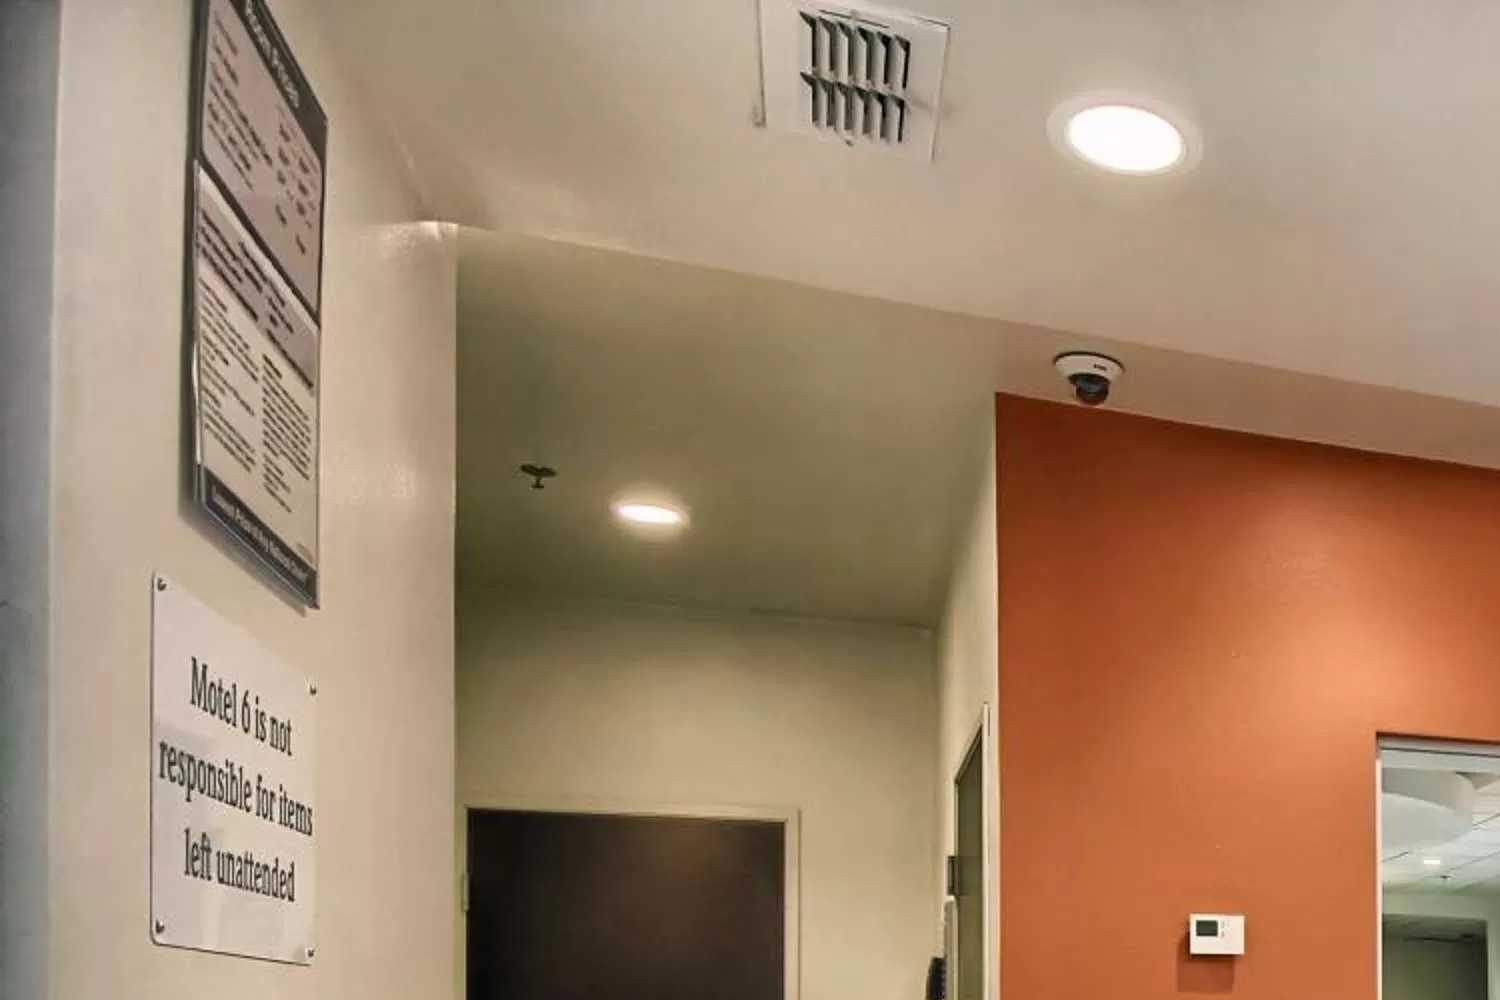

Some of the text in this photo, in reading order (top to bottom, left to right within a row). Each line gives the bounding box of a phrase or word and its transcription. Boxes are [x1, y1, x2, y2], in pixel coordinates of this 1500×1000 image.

[189, 656, 293, 757] Motel 6 is not
[159, 740, 313, 836] responsible for items
[184, 828, 295, 902] left unattended
